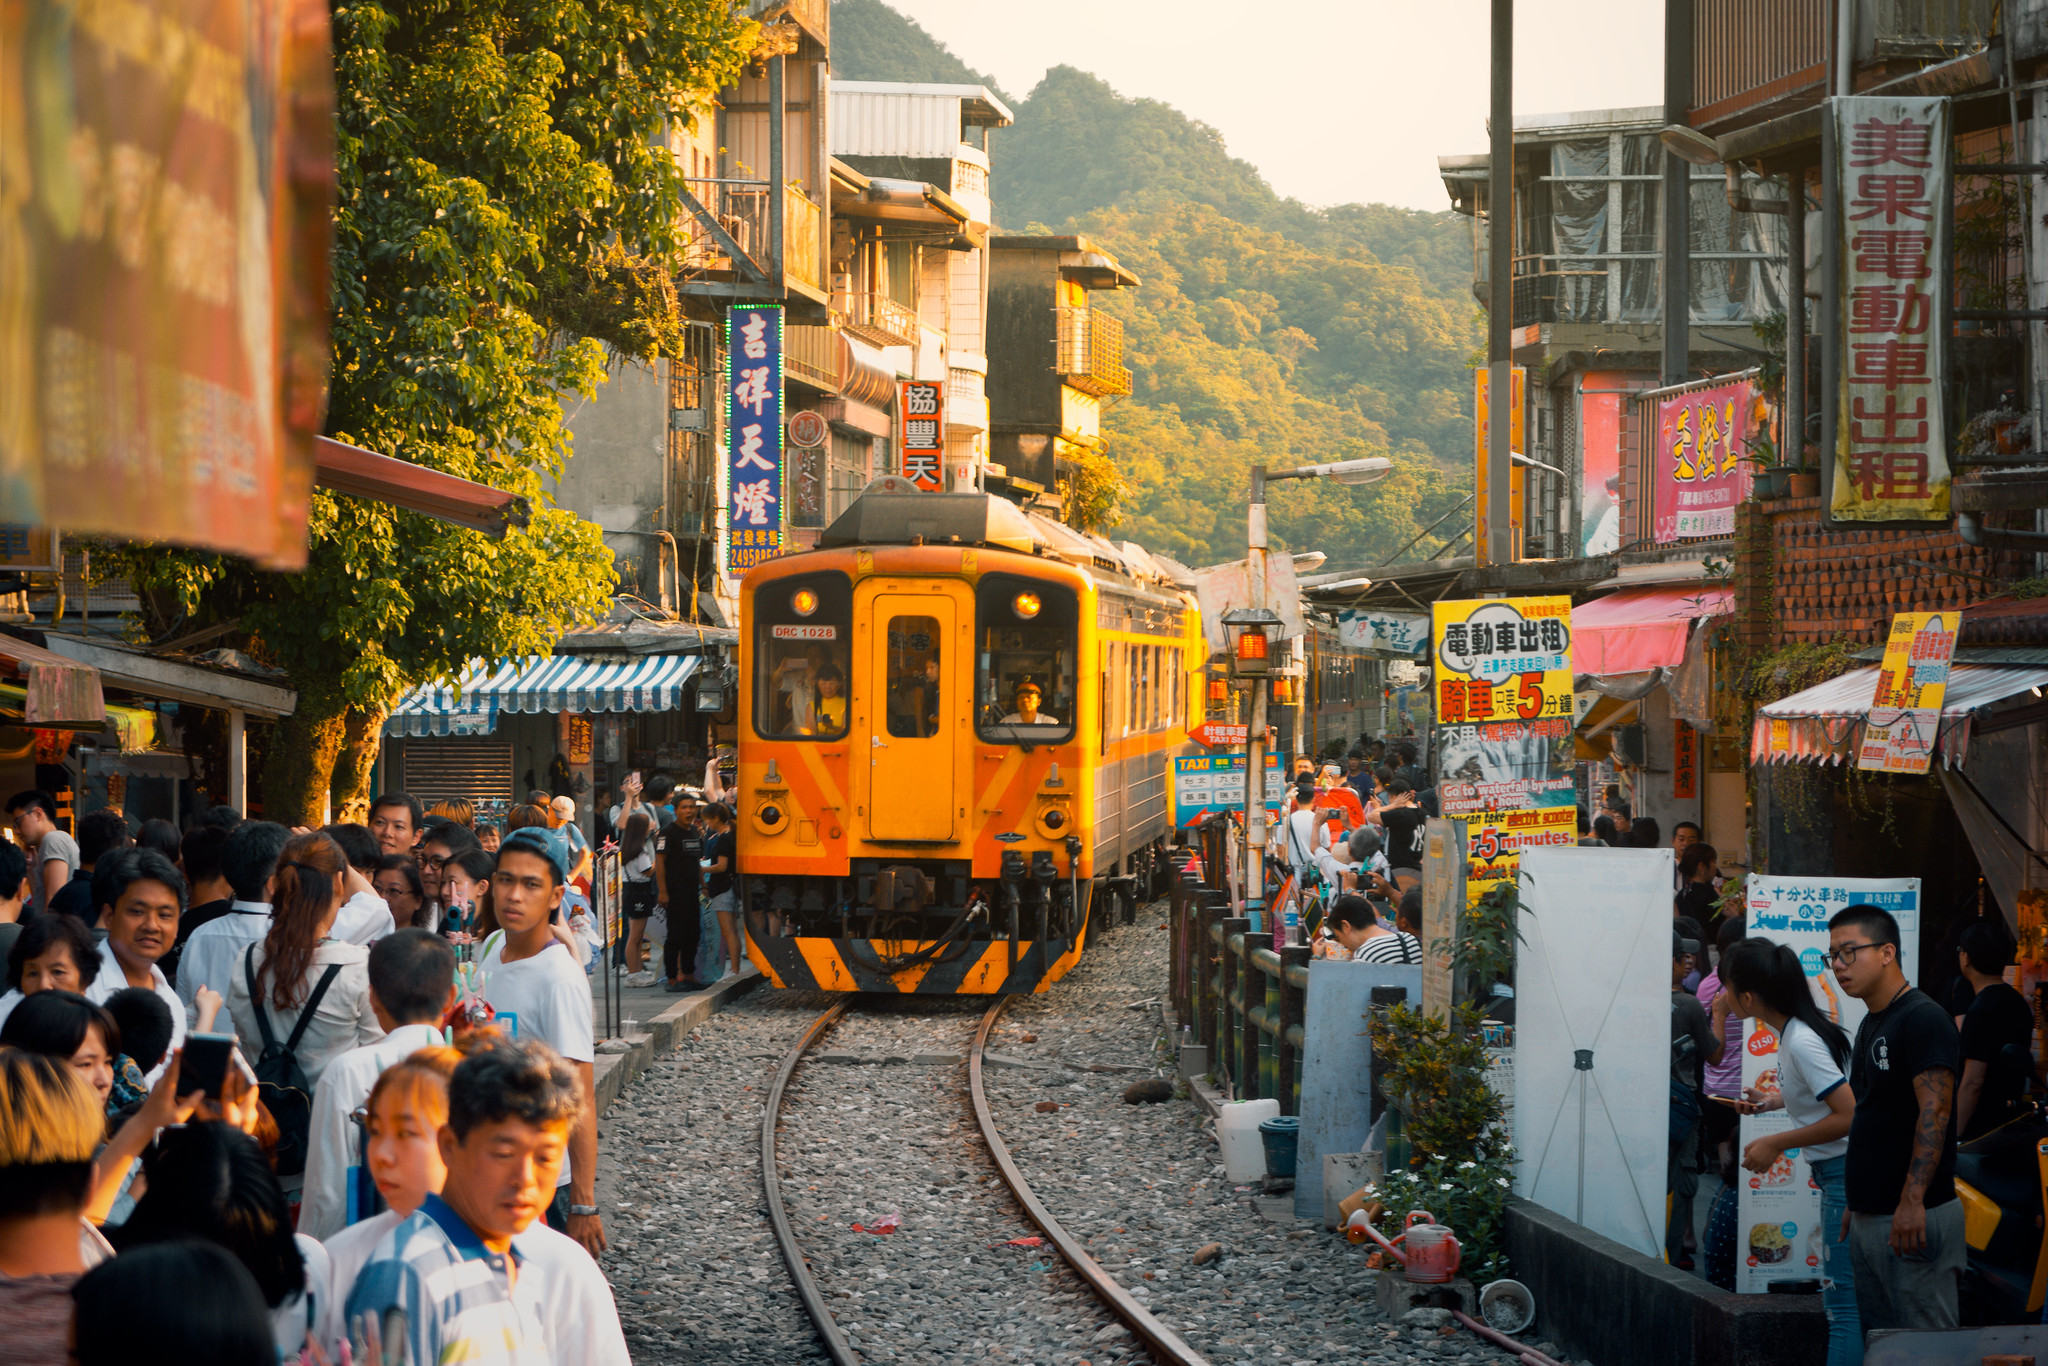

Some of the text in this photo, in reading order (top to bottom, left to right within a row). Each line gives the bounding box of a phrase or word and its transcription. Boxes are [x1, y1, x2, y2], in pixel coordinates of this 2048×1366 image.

[1848, 117, 1933, 501] 美果電動車出租
[733, 312, 776, 525] 吉祥天燈
[775, 627, 834, 638] DRC 1028
[1446, 619, 1562, 657] 電動車出租
[1209, 736, 1230, 744] TAXI
[1178, 758, 1211, 771] TAXI
[1185, 777, 1207, 785] 台北
[1219, 775, 1241, 783] 九份
[1443, 775, 1574, 798] Go to waterfall by walk
[1443, 796, 1485, 811] around
[1484, 811, 1506, 824] take
[1479, 827, 1498, 859] 5
[1500, 830, 1575, 849] minutes.
[1772, 885, 1848, 903] 十分火車路
[1800, 905, 1825, 918] 小吃
[1802, 954, 1822, 962] HOT
[1802, 963, 1822, 971] NO.1
[1750, 1034, 1774, 1051] $150
